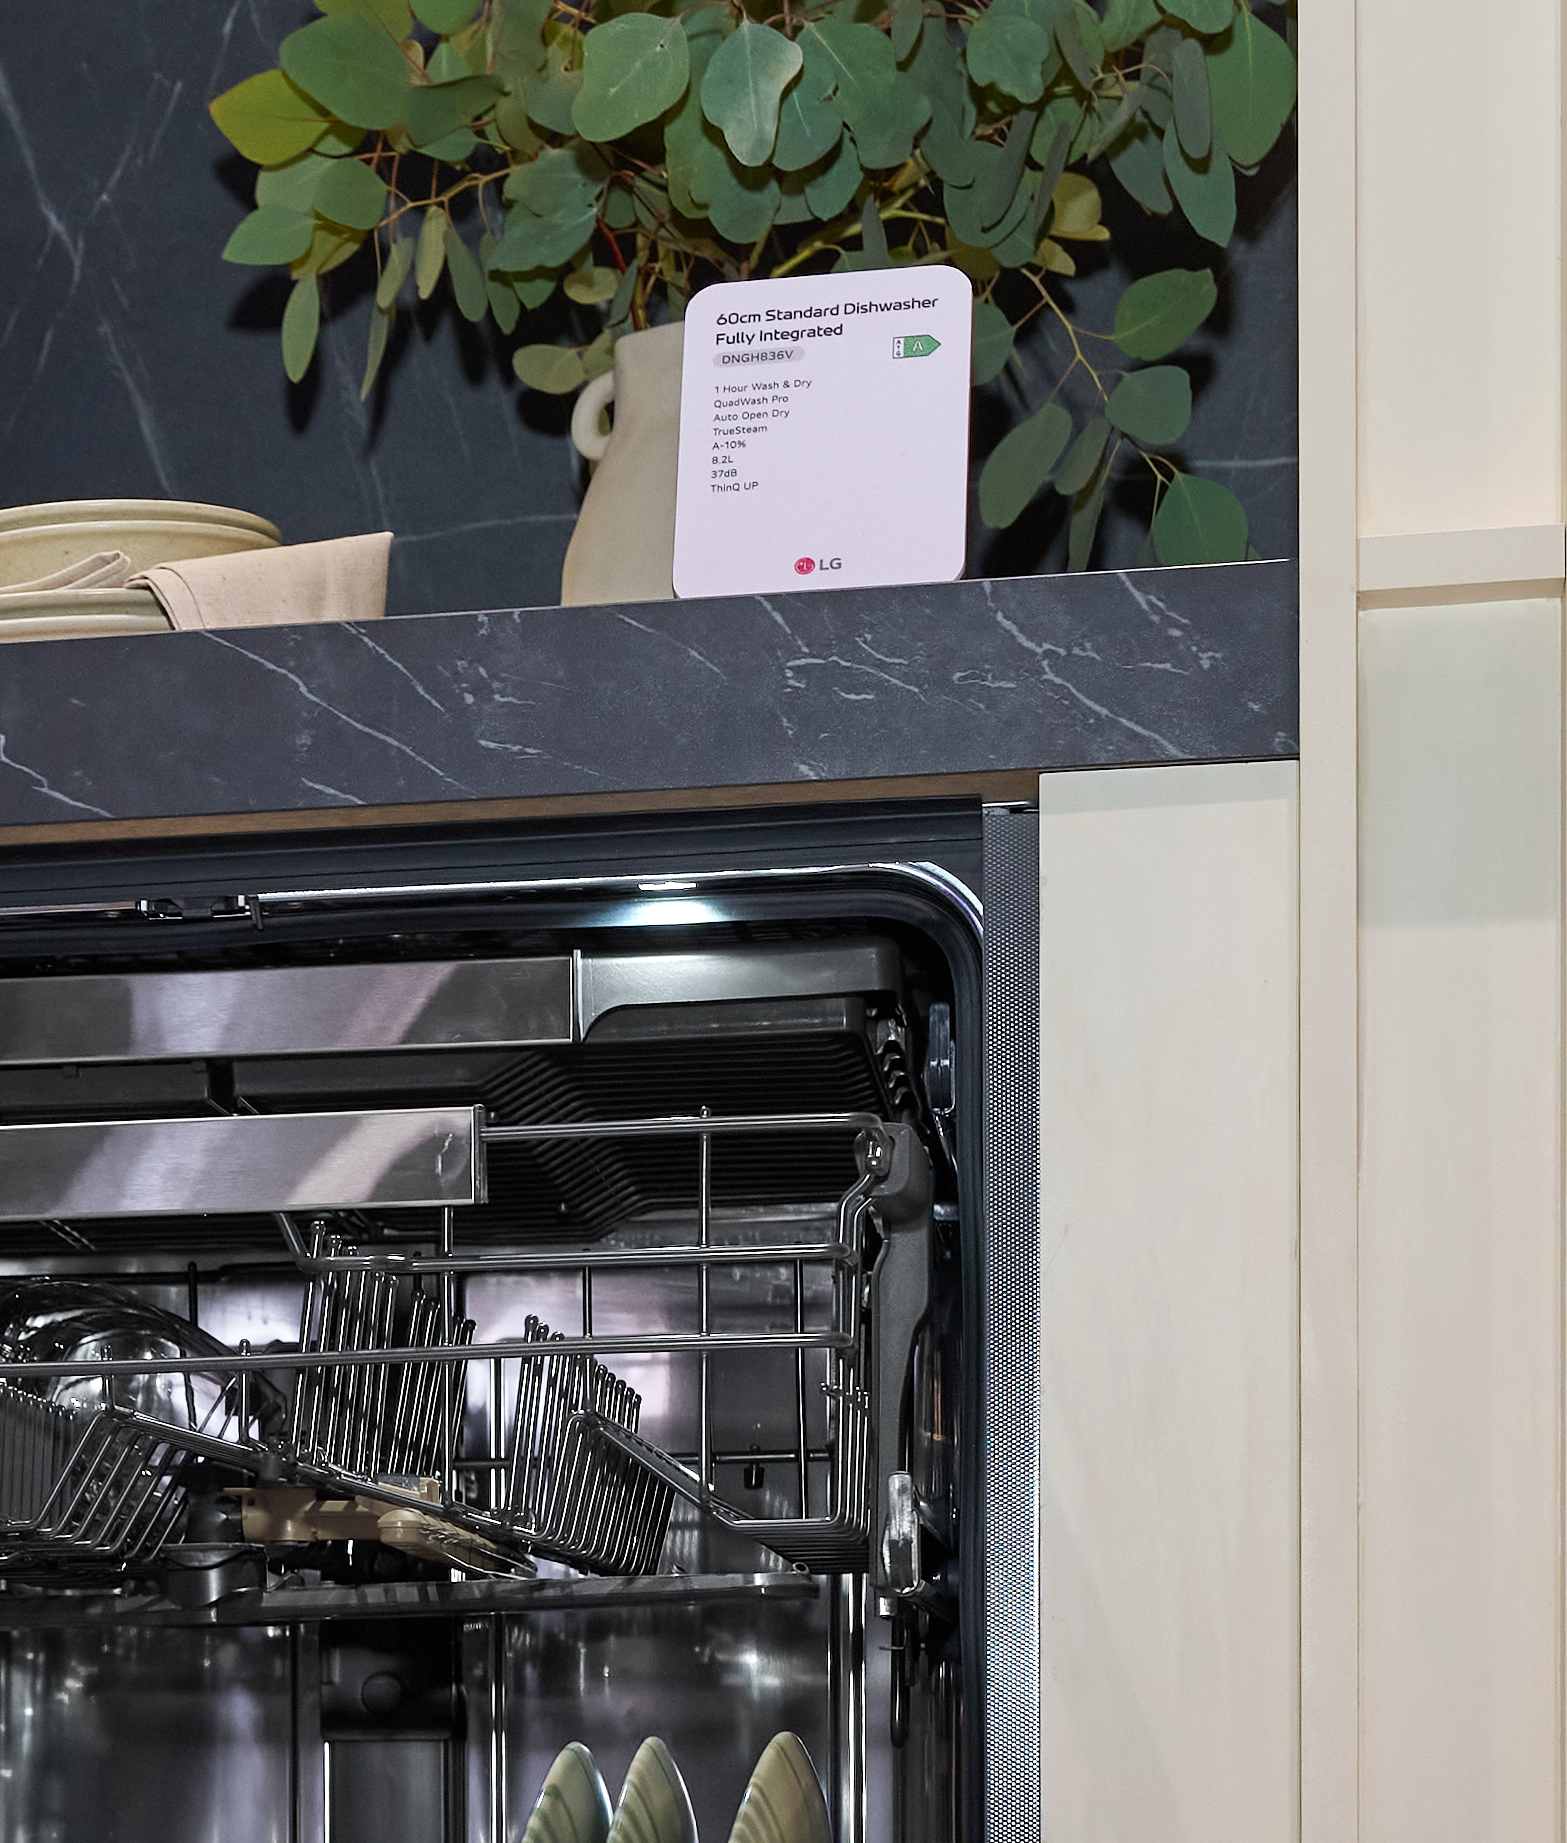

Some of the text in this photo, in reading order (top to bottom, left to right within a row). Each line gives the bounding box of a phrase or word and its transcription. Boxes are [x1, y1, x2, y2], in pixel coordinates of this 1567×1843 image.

[716, 297, 939, 326] 60cm Standard Dishwasher
[716, 323, 843, 346] Fully Integrated
[722, 350, 795, 366] DNGH836V
[715, 379, 812, 394] 1 Hour Wash & Dry
[713, 395, 789, 409] QuadWash Pro
[713, 409, 790, 422] Auto Open Dry
[713, 425, 768, 436] TrueSteam
[712, 440, 747, 450] A-10%
[712, 455, 734, 465] 8.2L
[711, 469, 738, 479] 37dB
[711, 481, 759, 493] ThinQ UP
[819, 557, 842, 571] LG
